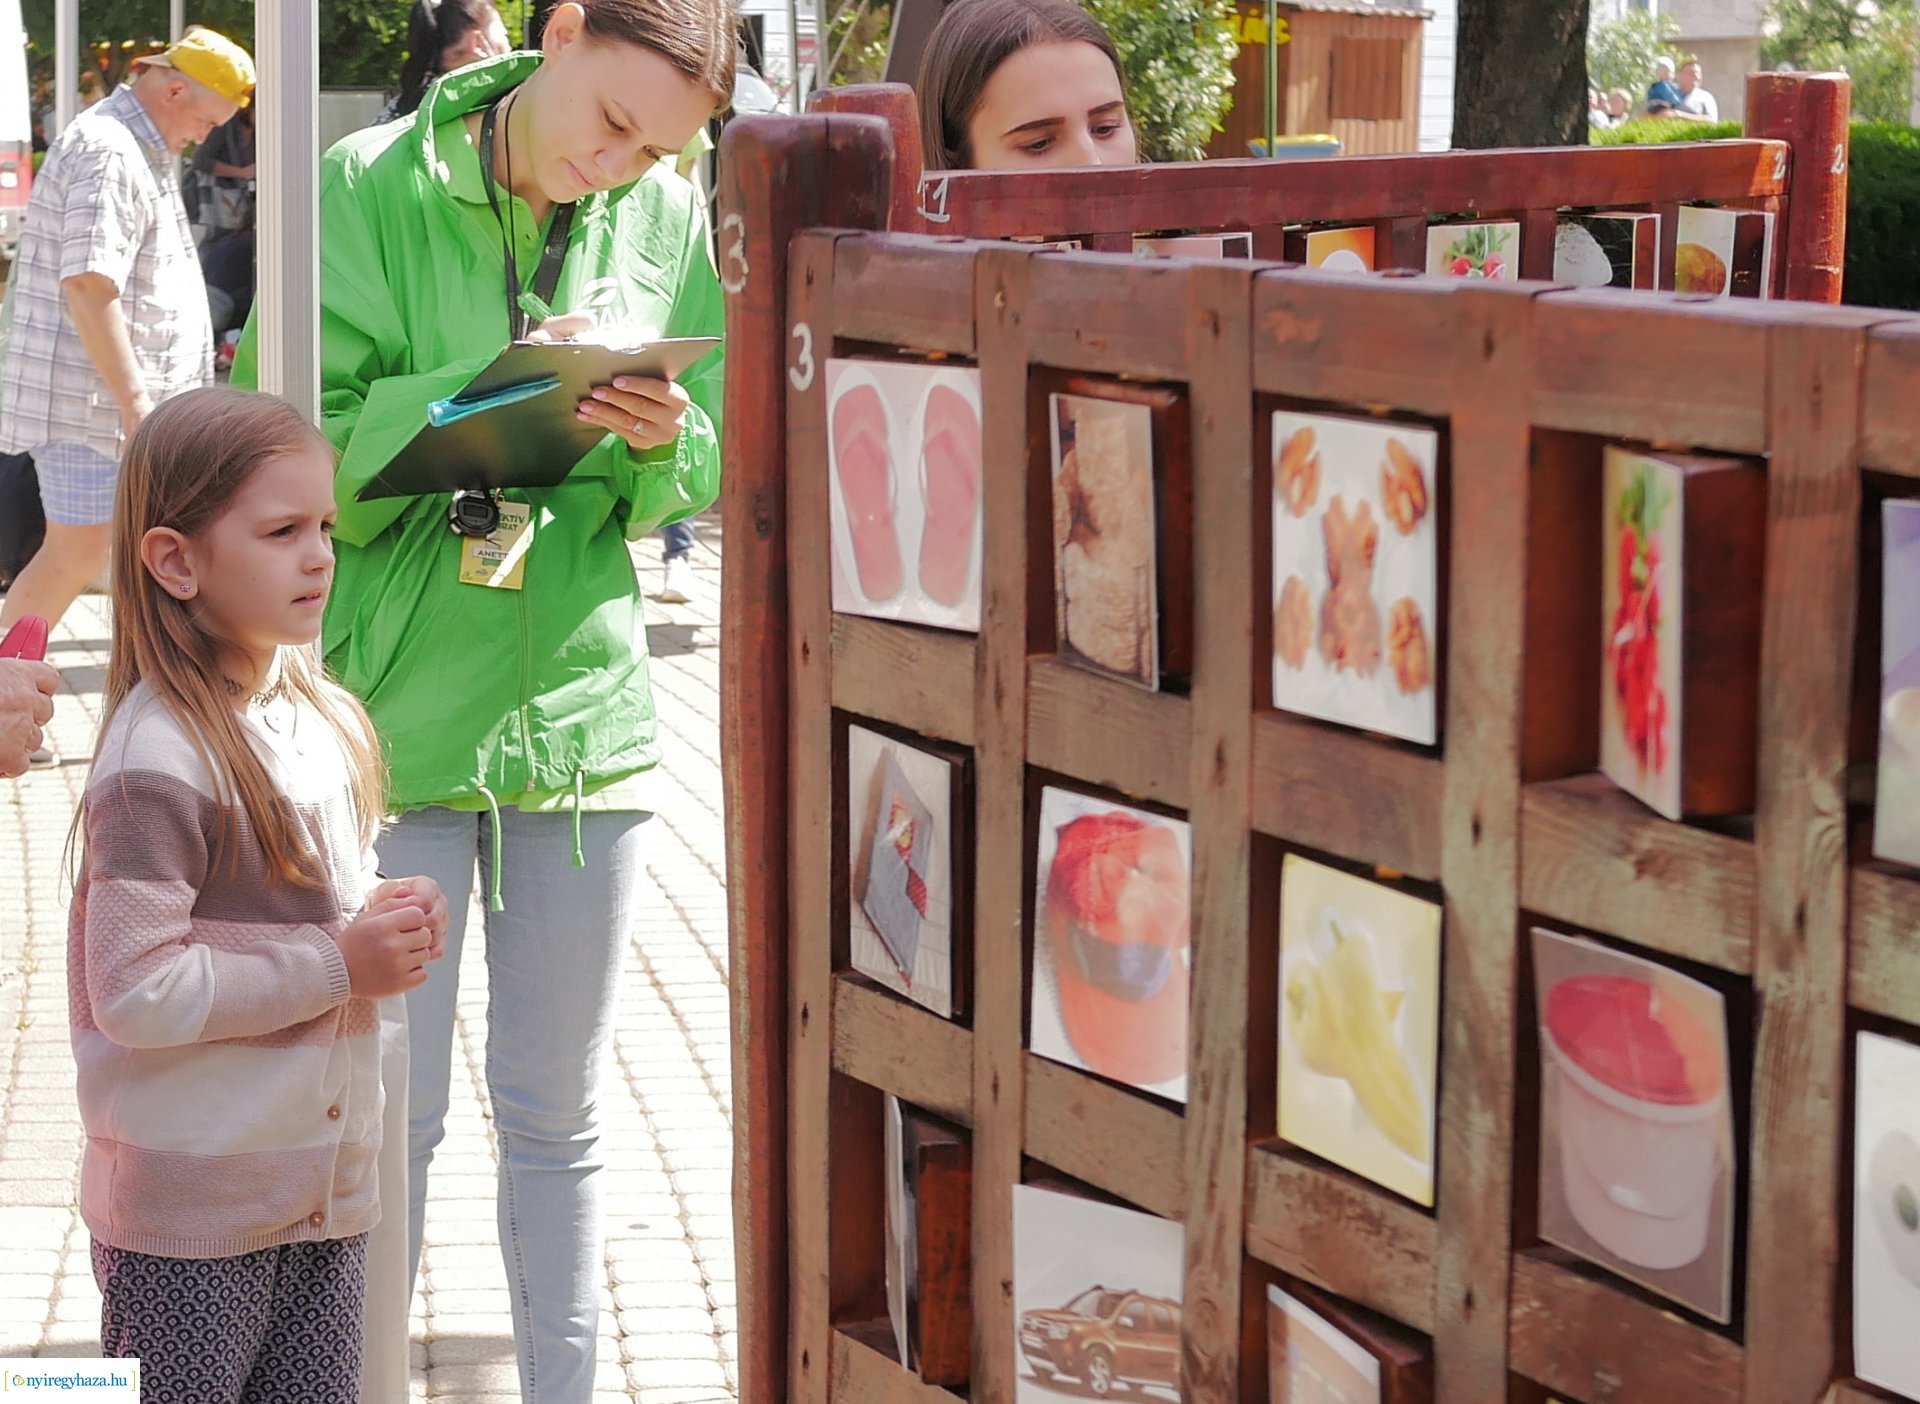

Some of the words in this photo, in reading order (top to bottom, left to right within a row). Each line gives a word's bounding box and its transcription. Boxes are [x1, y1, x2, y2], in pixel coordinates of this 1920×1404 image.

[1772, 151, 1786, 180] 2
[1831, 144, 1844, 175] 2
[723, 213, 749, 293] 3
[789, 322, 815, 392] 3
